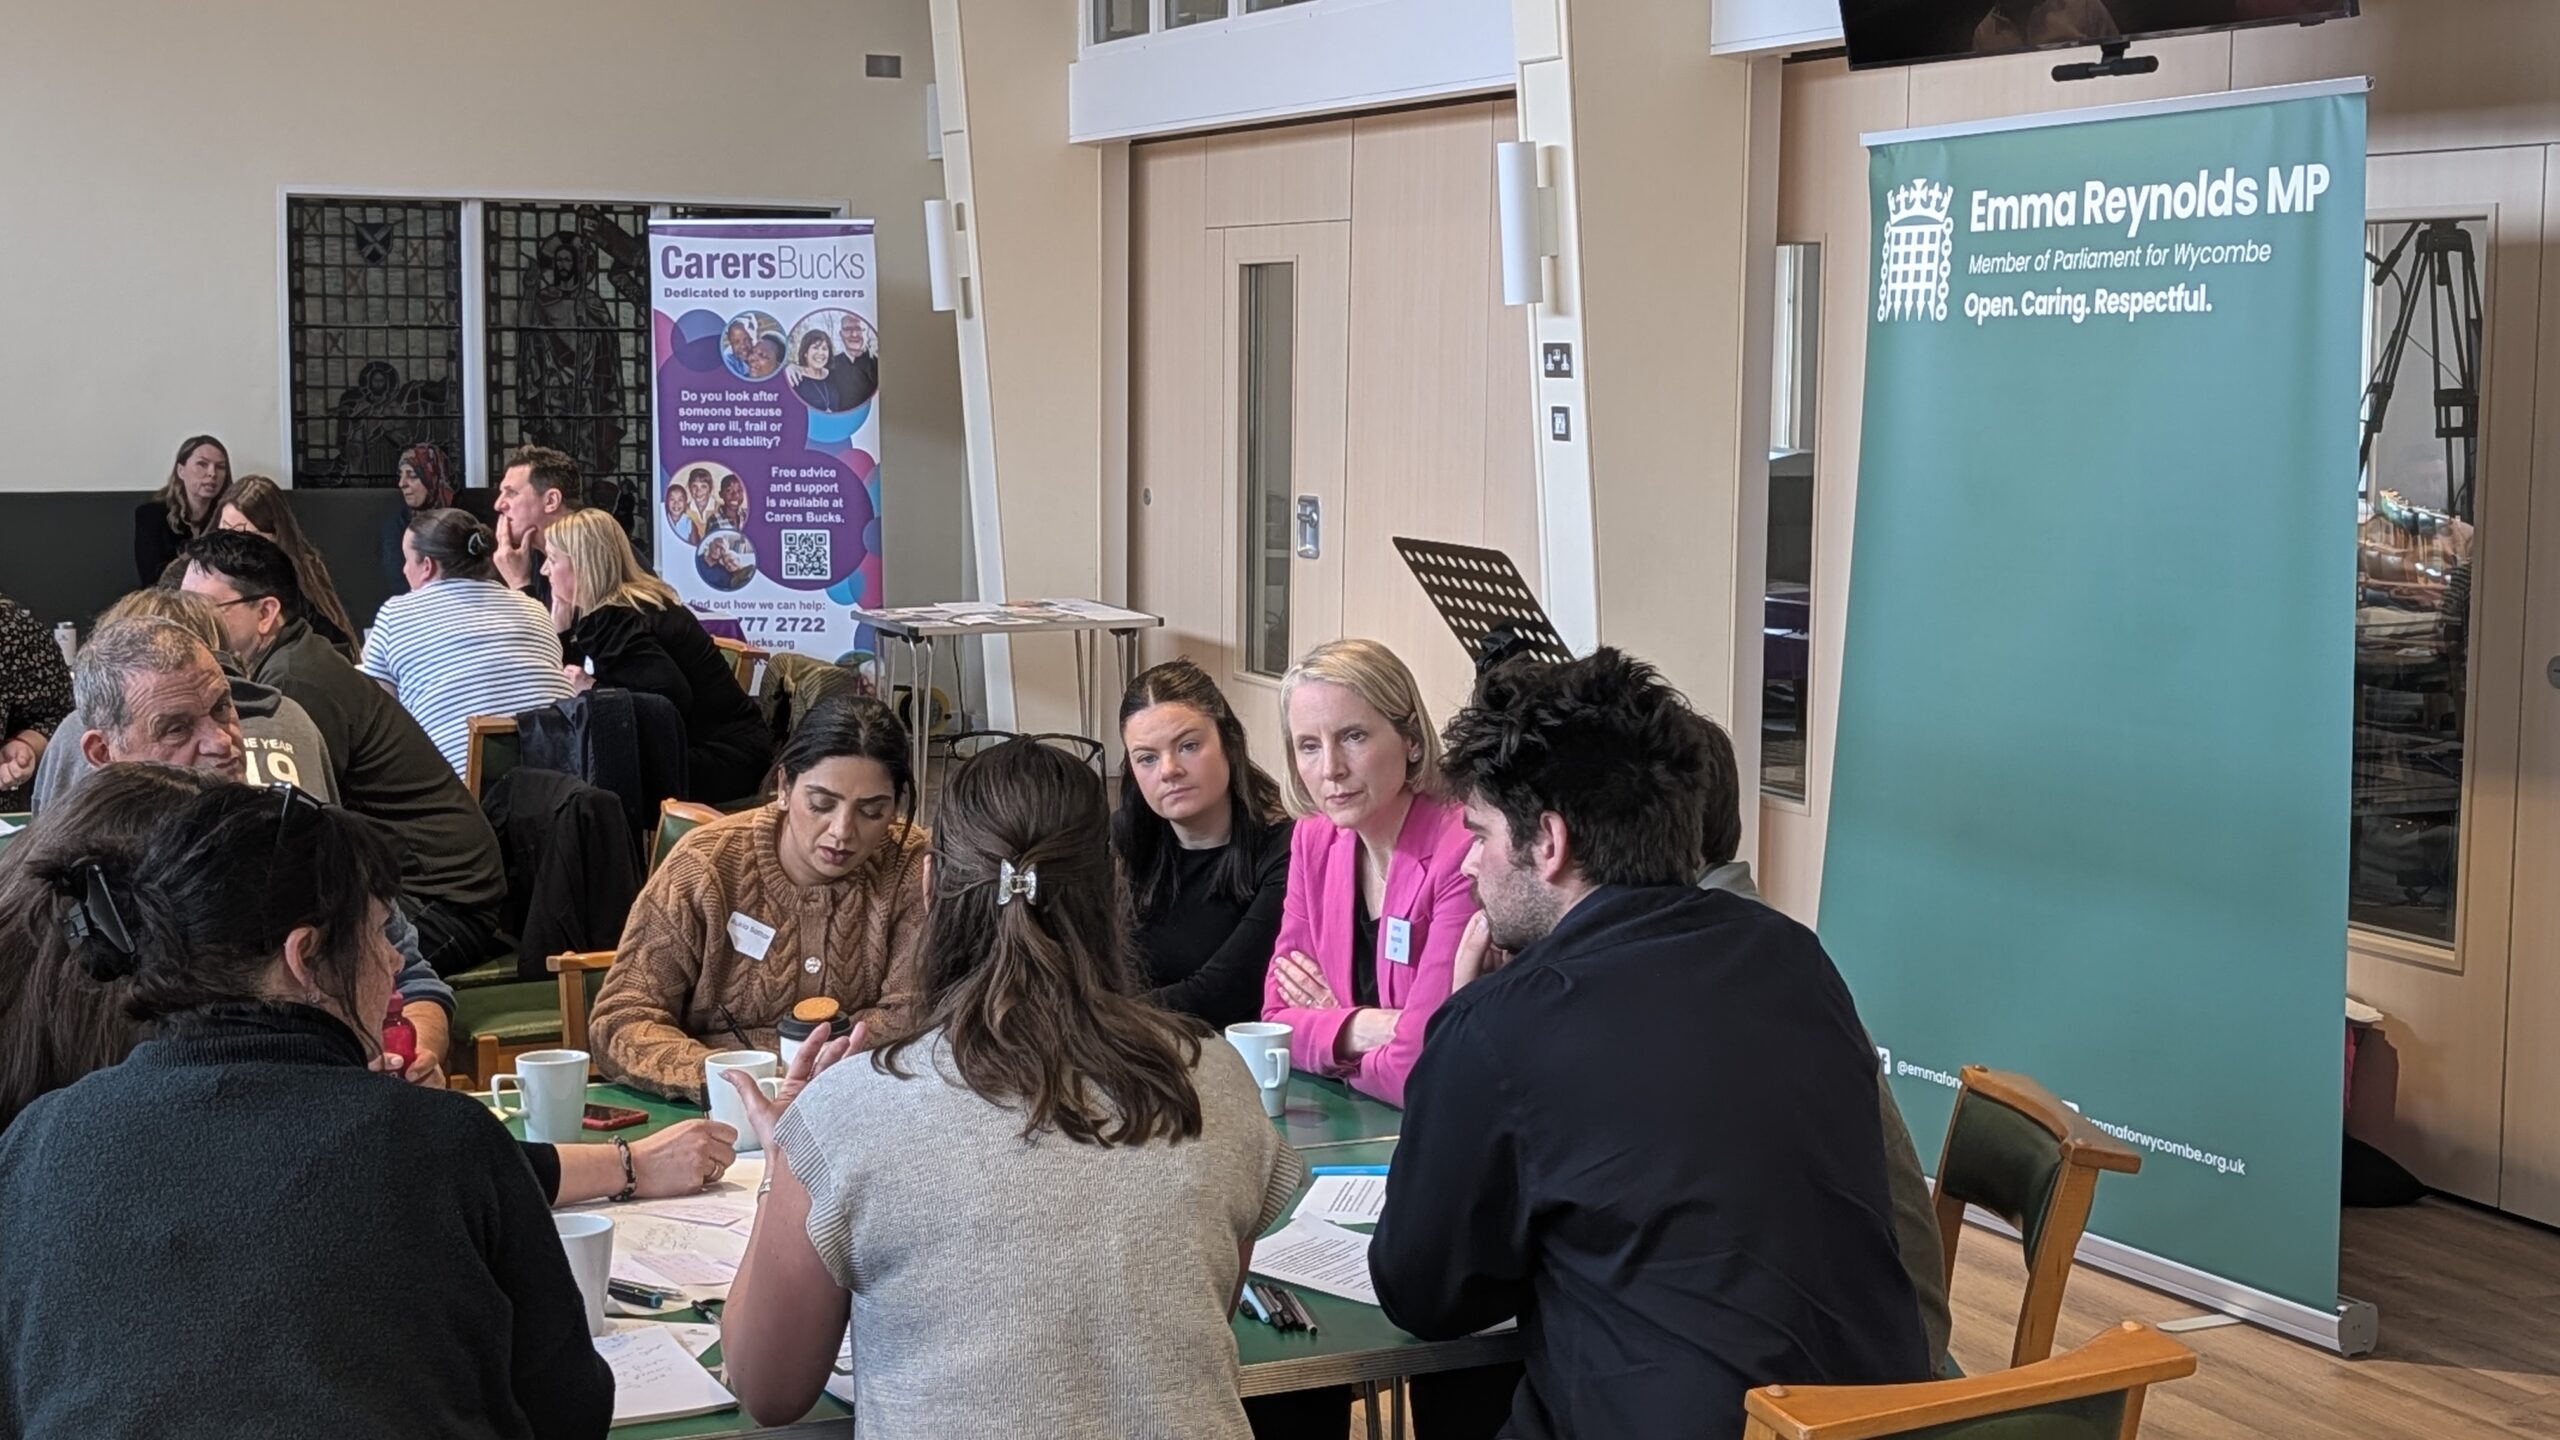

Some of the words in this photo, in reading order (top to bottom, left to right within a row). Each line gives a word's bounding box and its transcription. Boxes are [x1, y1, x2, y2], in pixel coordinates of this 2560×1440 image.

[1970, 190, 2077, 233] Emma
[2083, 167, 2259, 238] Reynolds
[2267, 163, 2330, 214] MP
[661, 245, 866, 280] CarersBucks
[1968, 251, 2032, 275] Member
[2034, 248, 2051, 272] of
[2053, 246, 2142, 271] Parliament
[2145, 243, 2170, 266] for
[2174, 239, 2272, 272] Wycombe
[664, 287, 729, 299] Dedicated
[733, 288, 746, 299] to
[749, 287, 819, 301] supporting
[822, 288, 865, 299] carers
[1964, 292, 2019, 326] Open.
[2021, 286, 2091, 324] Caring.
[2094, 282, 2213, 323] Respectful.
[681, 390, 698, 402] Do
[700, 392, 722, 404] you
[725, 390, 750, 402] look
[752, 390, 779, 402] after
[678, 407, 732, 417] someone
[734, 405, 783, 417] because
[679, 420, 705, 434] they
[707, 422, 727, 432] are
[729, 420, 742, 433] ill,
[745, 420, 767, 432] frail
[769, 422, 783, 432] or
[681, 435, 710, 447] have
[712, 437, 720, 447] a
[722, 435, 781, 449] disability?
[771, 466, 797, 478] Free
[799, 466, 837, 478] advice
[769, 482, 792, 493] and
[794, 482, 839, 495] support
[766, 496, 777, 508] is
[779, 496, 830, 508] available
[831, 497, 844, 508] at
[765, 511, 803, 523] Carers
[805, 511, 845, 523] Bucks.
[713, 602, 731, 610] out
[733, 600, 754, 610] how
[759, 601, 775, 610] we
[777, 601, 797, 610] can
[799, 600, 826, 612] help:
[775, 616, 826, 633] 2722
[260, 738, 294, 754] YEAR
[2086, 1116, 2246, 1176] mmaforwycombe.org.uk
